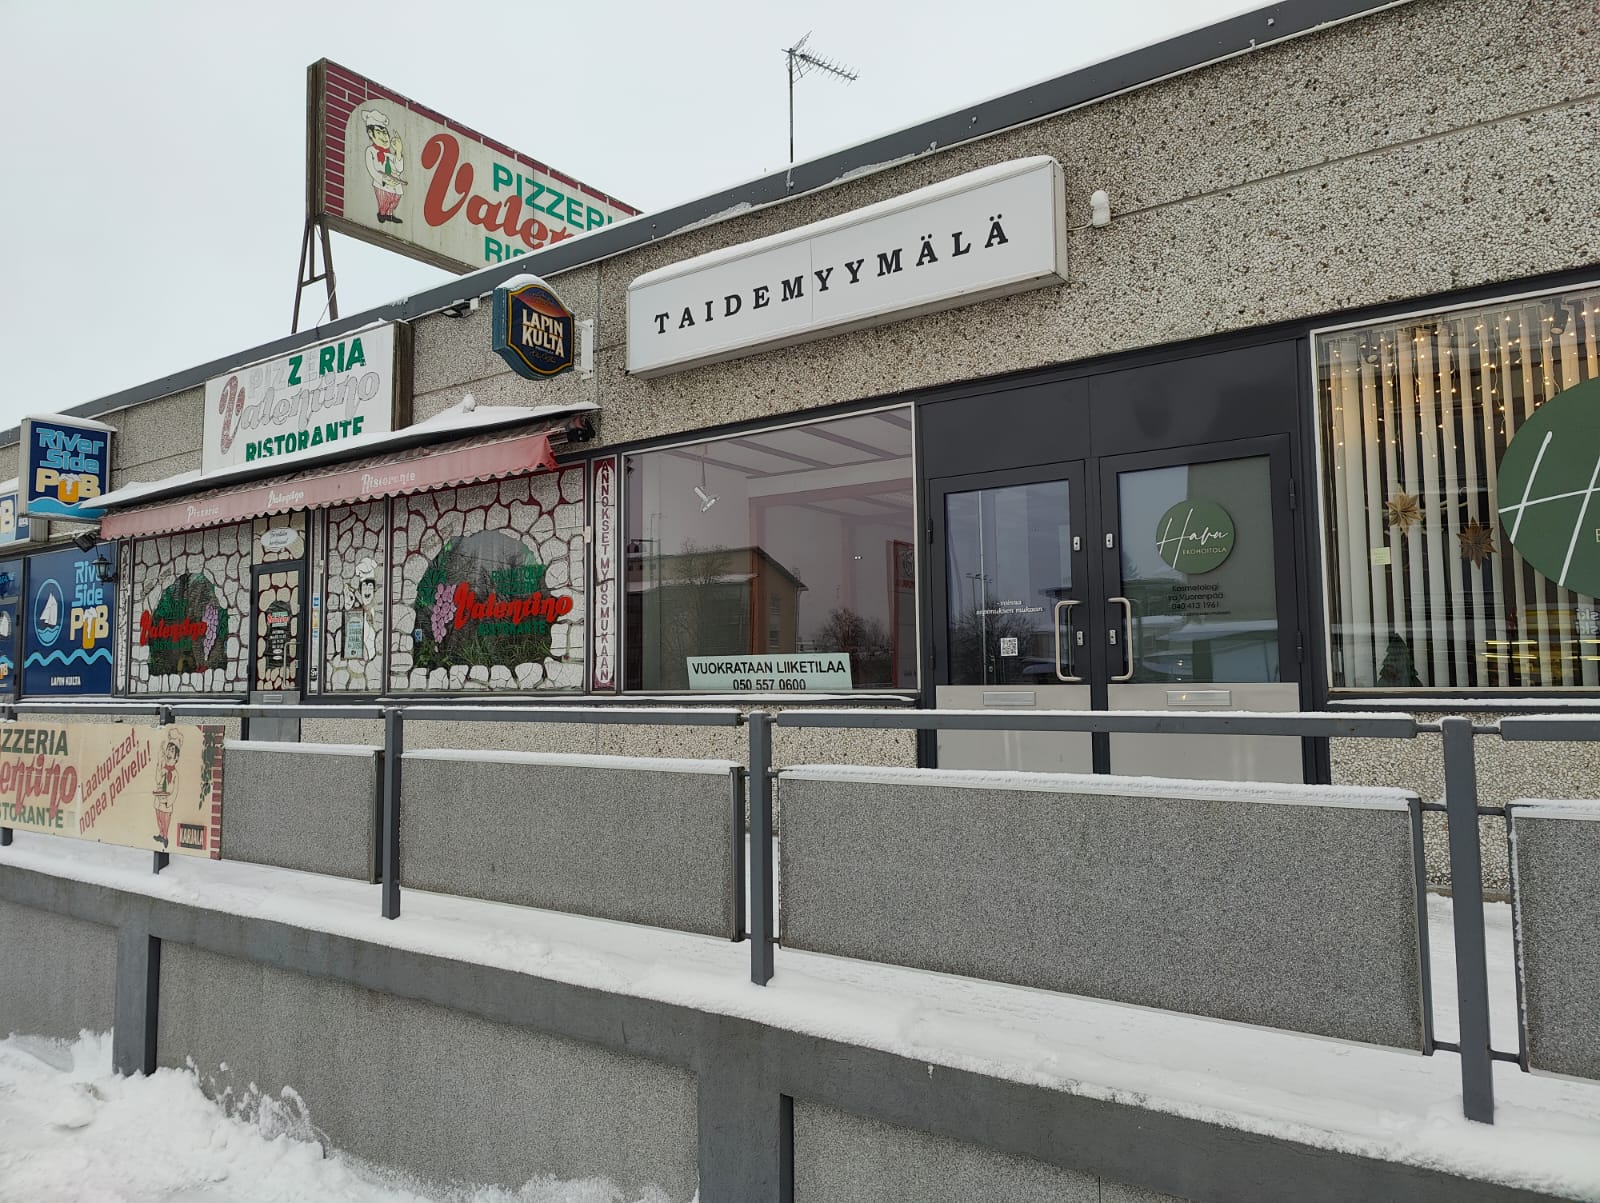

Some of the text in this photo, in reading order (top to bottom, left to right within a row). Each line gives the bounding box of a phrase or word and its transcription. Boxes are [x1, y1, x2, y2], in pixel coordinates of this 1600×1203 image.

[654, 214, 1008, 334] TAIDEMYYMÄLÄ
[522, 309, 563, 337] LAPIN
[522, 325, 565, 358] KULTA
[245, 416, 364, 462] RISTORANTE
[40, 449, 99, 474] Side
[692, 660, 846, 674] VUOKRATAAN LIIKETILAA
[733, 679, 806, 690] 050 557 0600
[79, 740, 151, 834] nopea palvelu!
